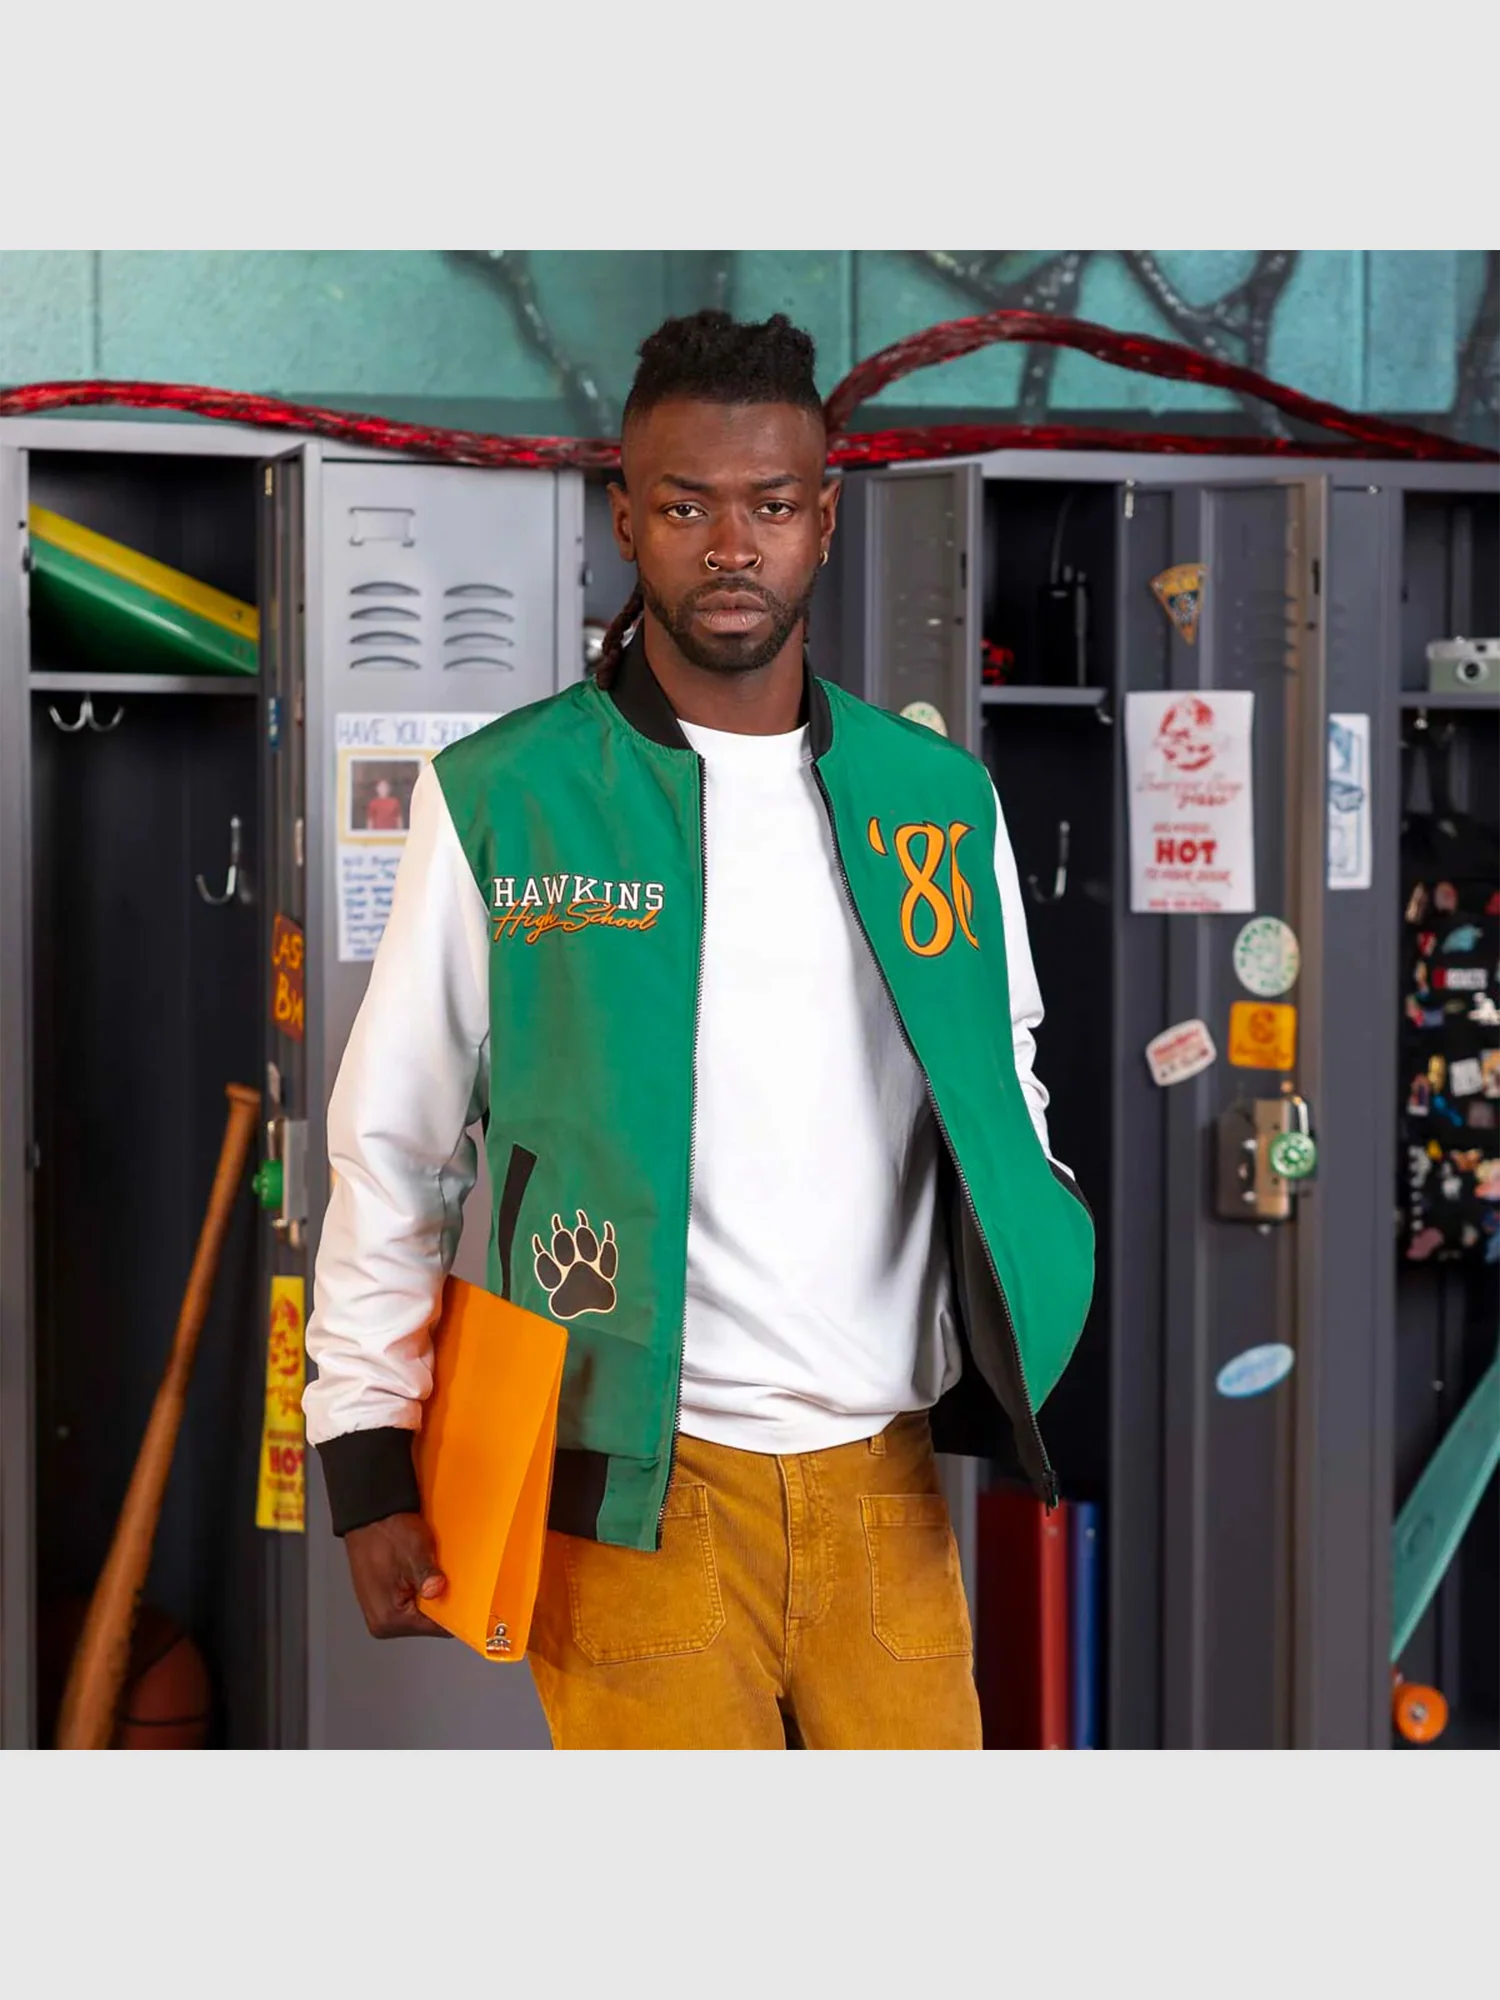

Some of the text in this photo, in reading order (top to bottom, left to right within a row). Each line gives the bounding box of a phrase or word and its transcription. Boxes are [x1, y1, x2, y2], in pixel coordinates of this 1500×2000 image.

[1154, 838, 1218, 866] HOT
[491, 873, 666, 911] HAWKINS
[492, 898, 658, 944] High School
